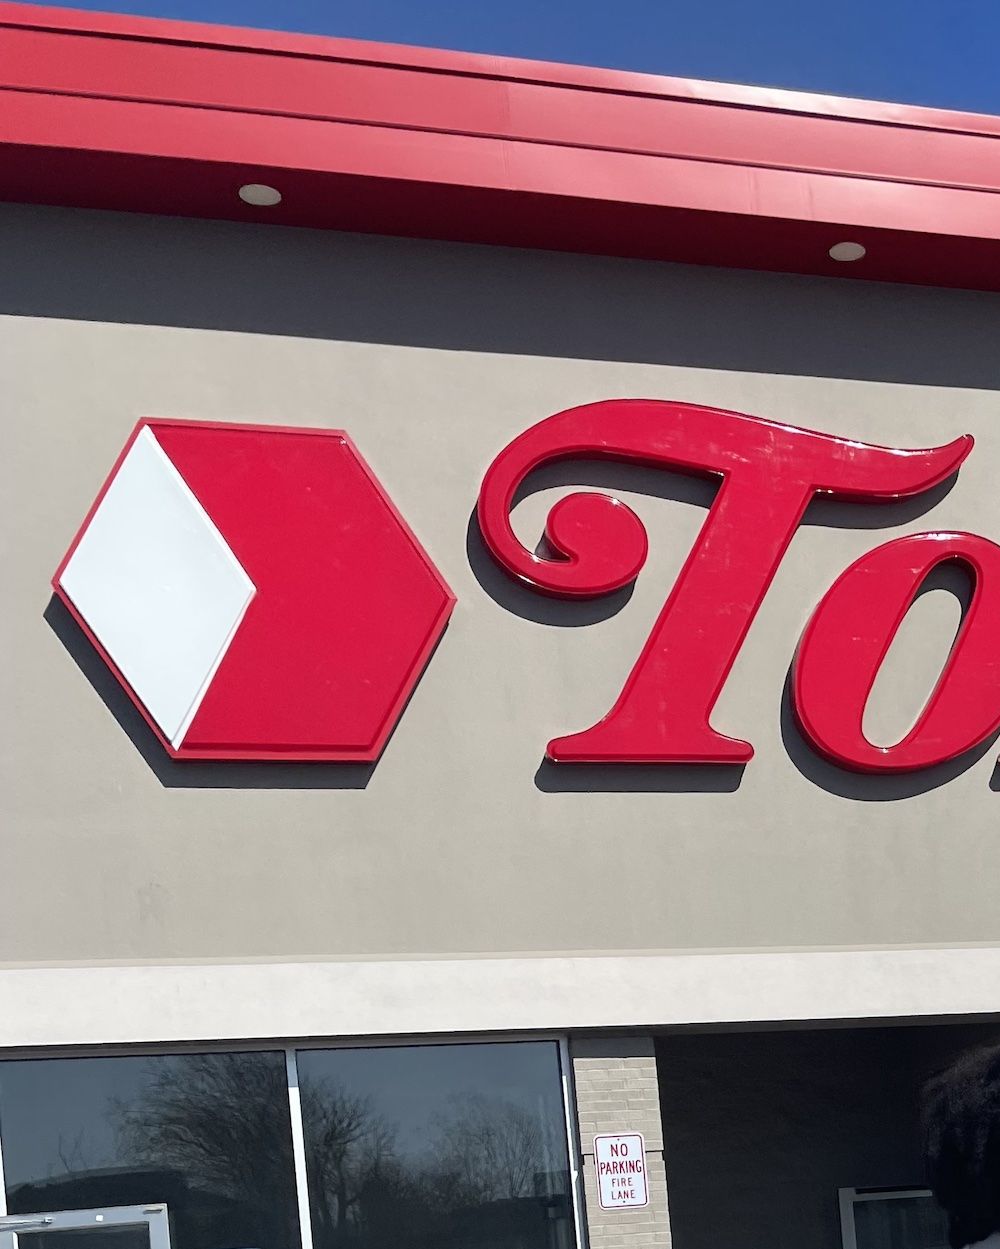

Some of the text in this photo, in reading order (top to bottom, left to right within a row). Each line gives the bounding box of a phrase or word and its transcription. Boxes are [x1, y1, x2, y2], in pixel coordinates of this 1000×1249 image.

[610, 1143, 628, 1157] NO
[600, 1159, 642, 1175] PARKING
[612, 1177, 633, 1187] FIRE
[611, 1189, 636, 1200] LANE
